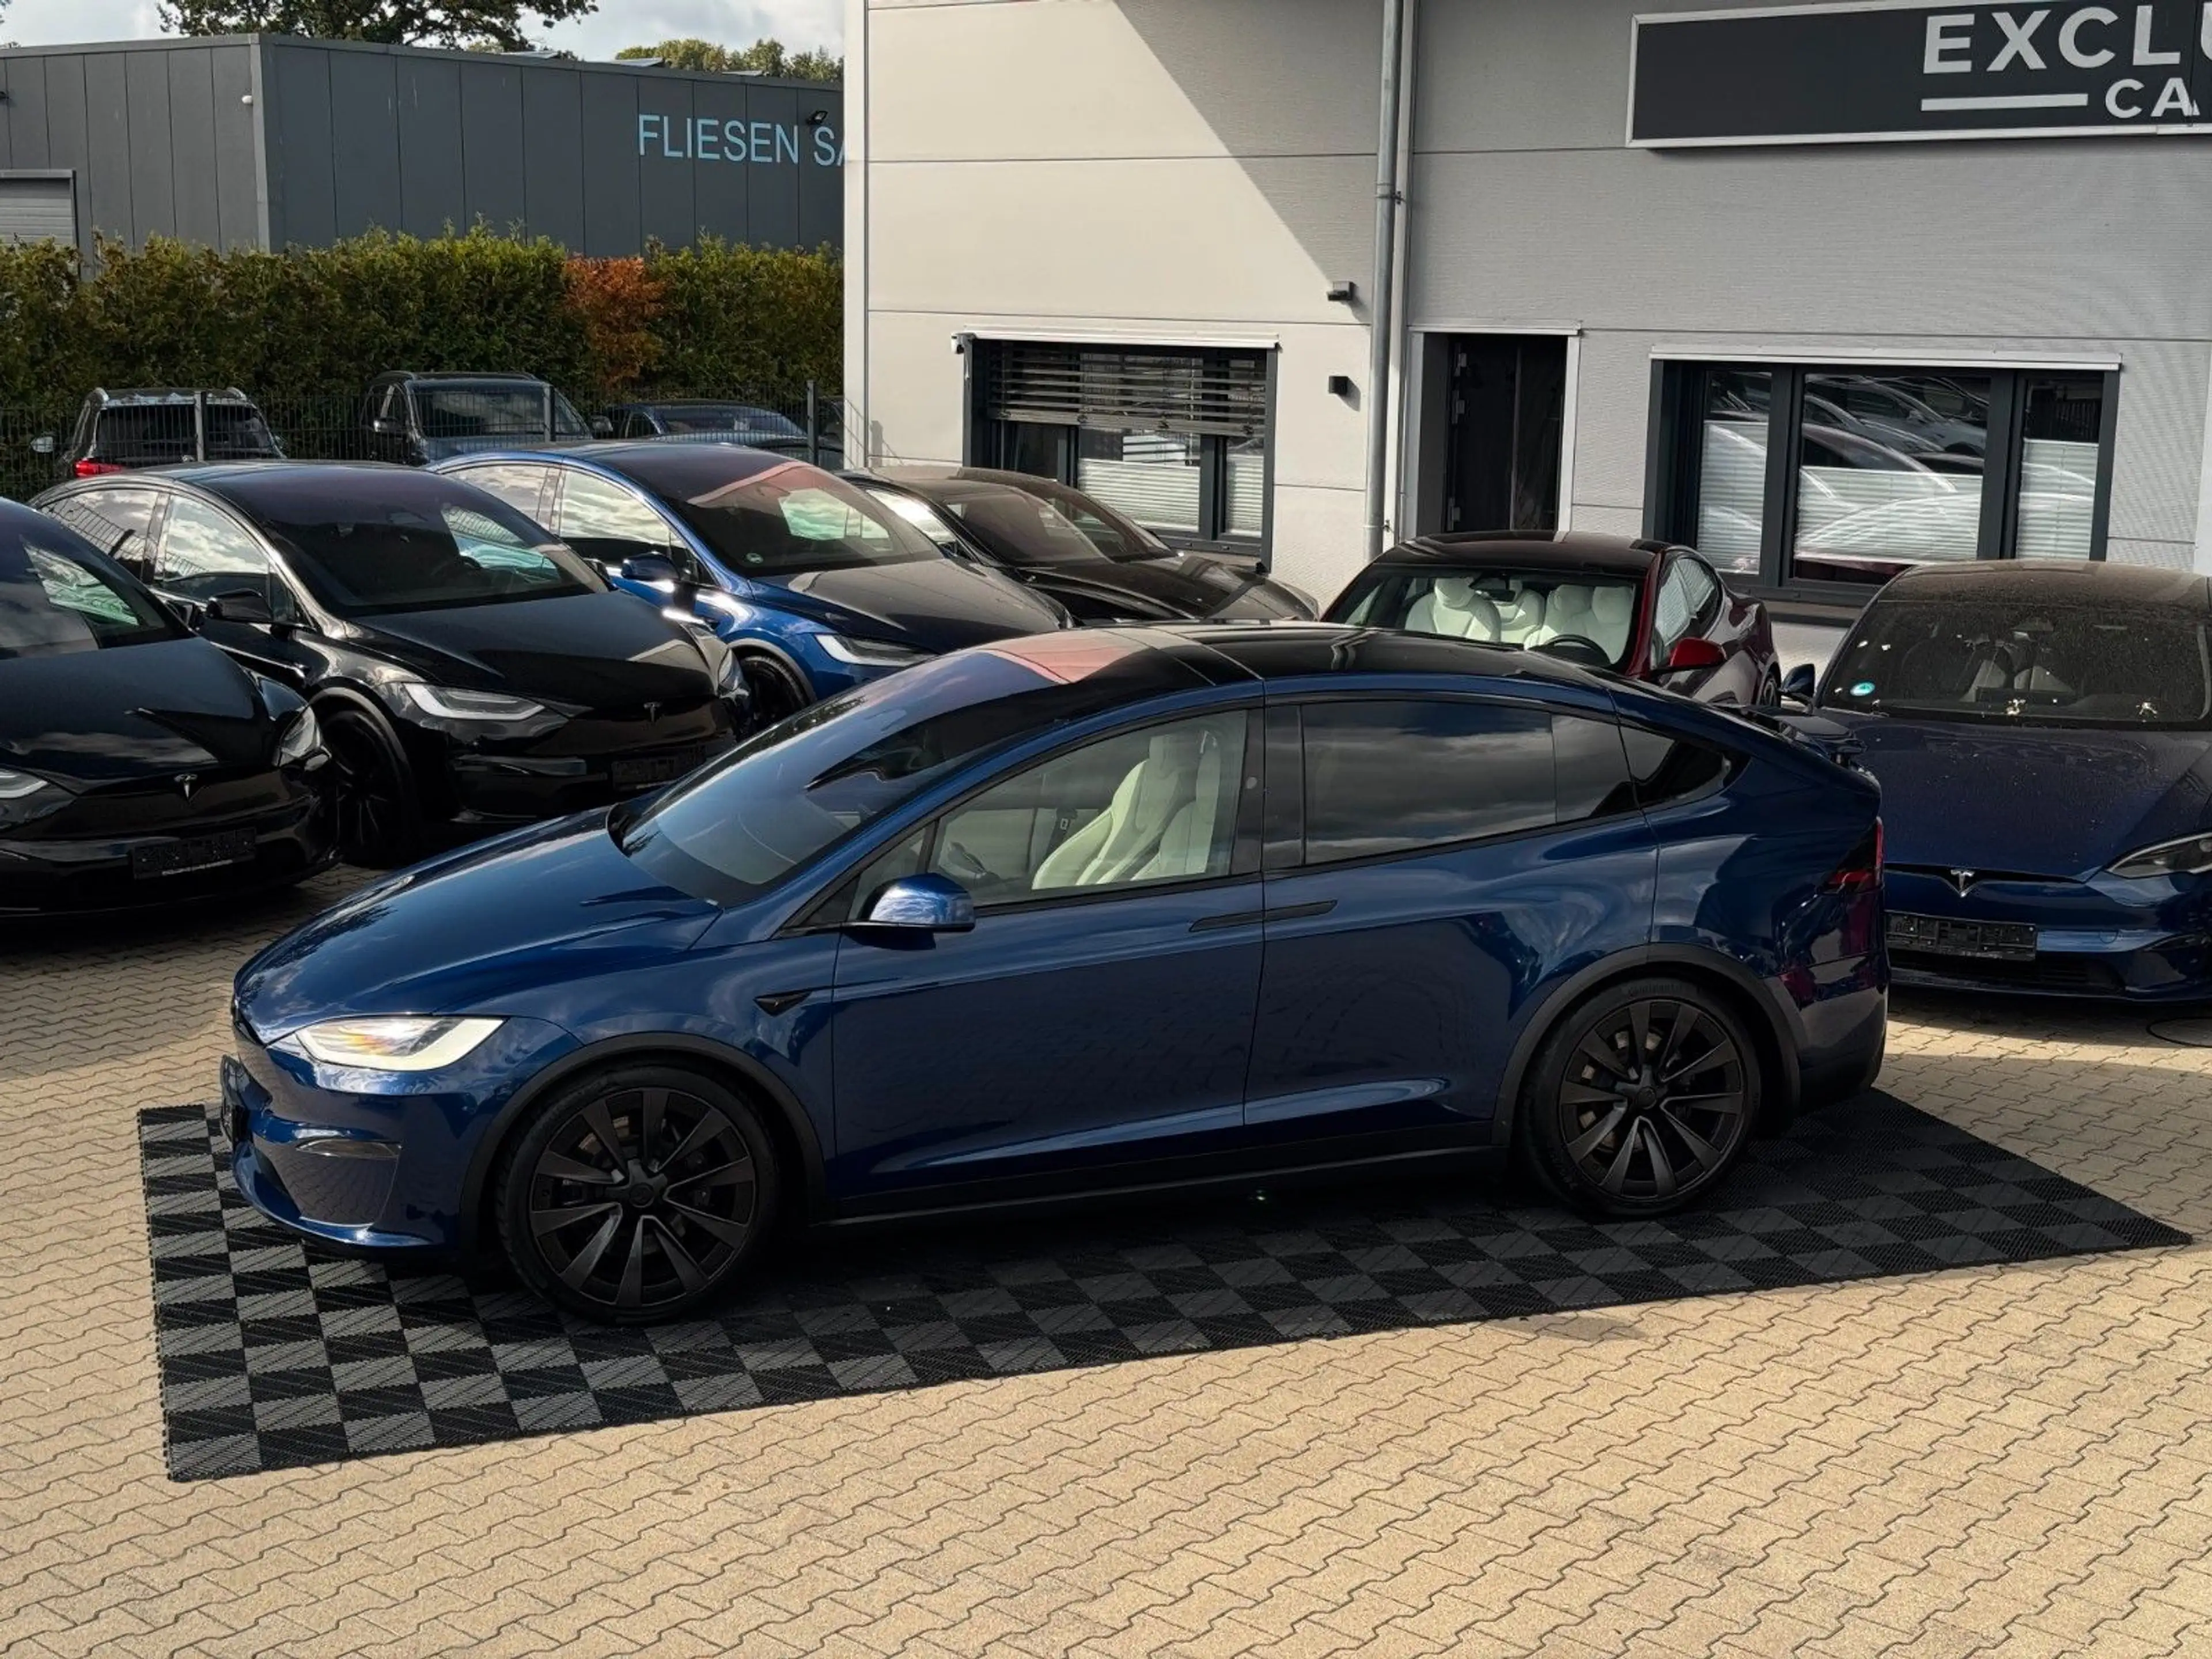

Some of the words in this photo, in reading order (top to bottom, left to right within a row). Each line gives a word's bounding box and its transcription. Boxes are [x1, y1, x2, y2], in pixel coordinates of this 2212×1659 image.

[1923, 2, 2212, 74] EXCL
[2105, 77, 2200, 119] CA
[638, 114, 798, 164] FLIESEN
